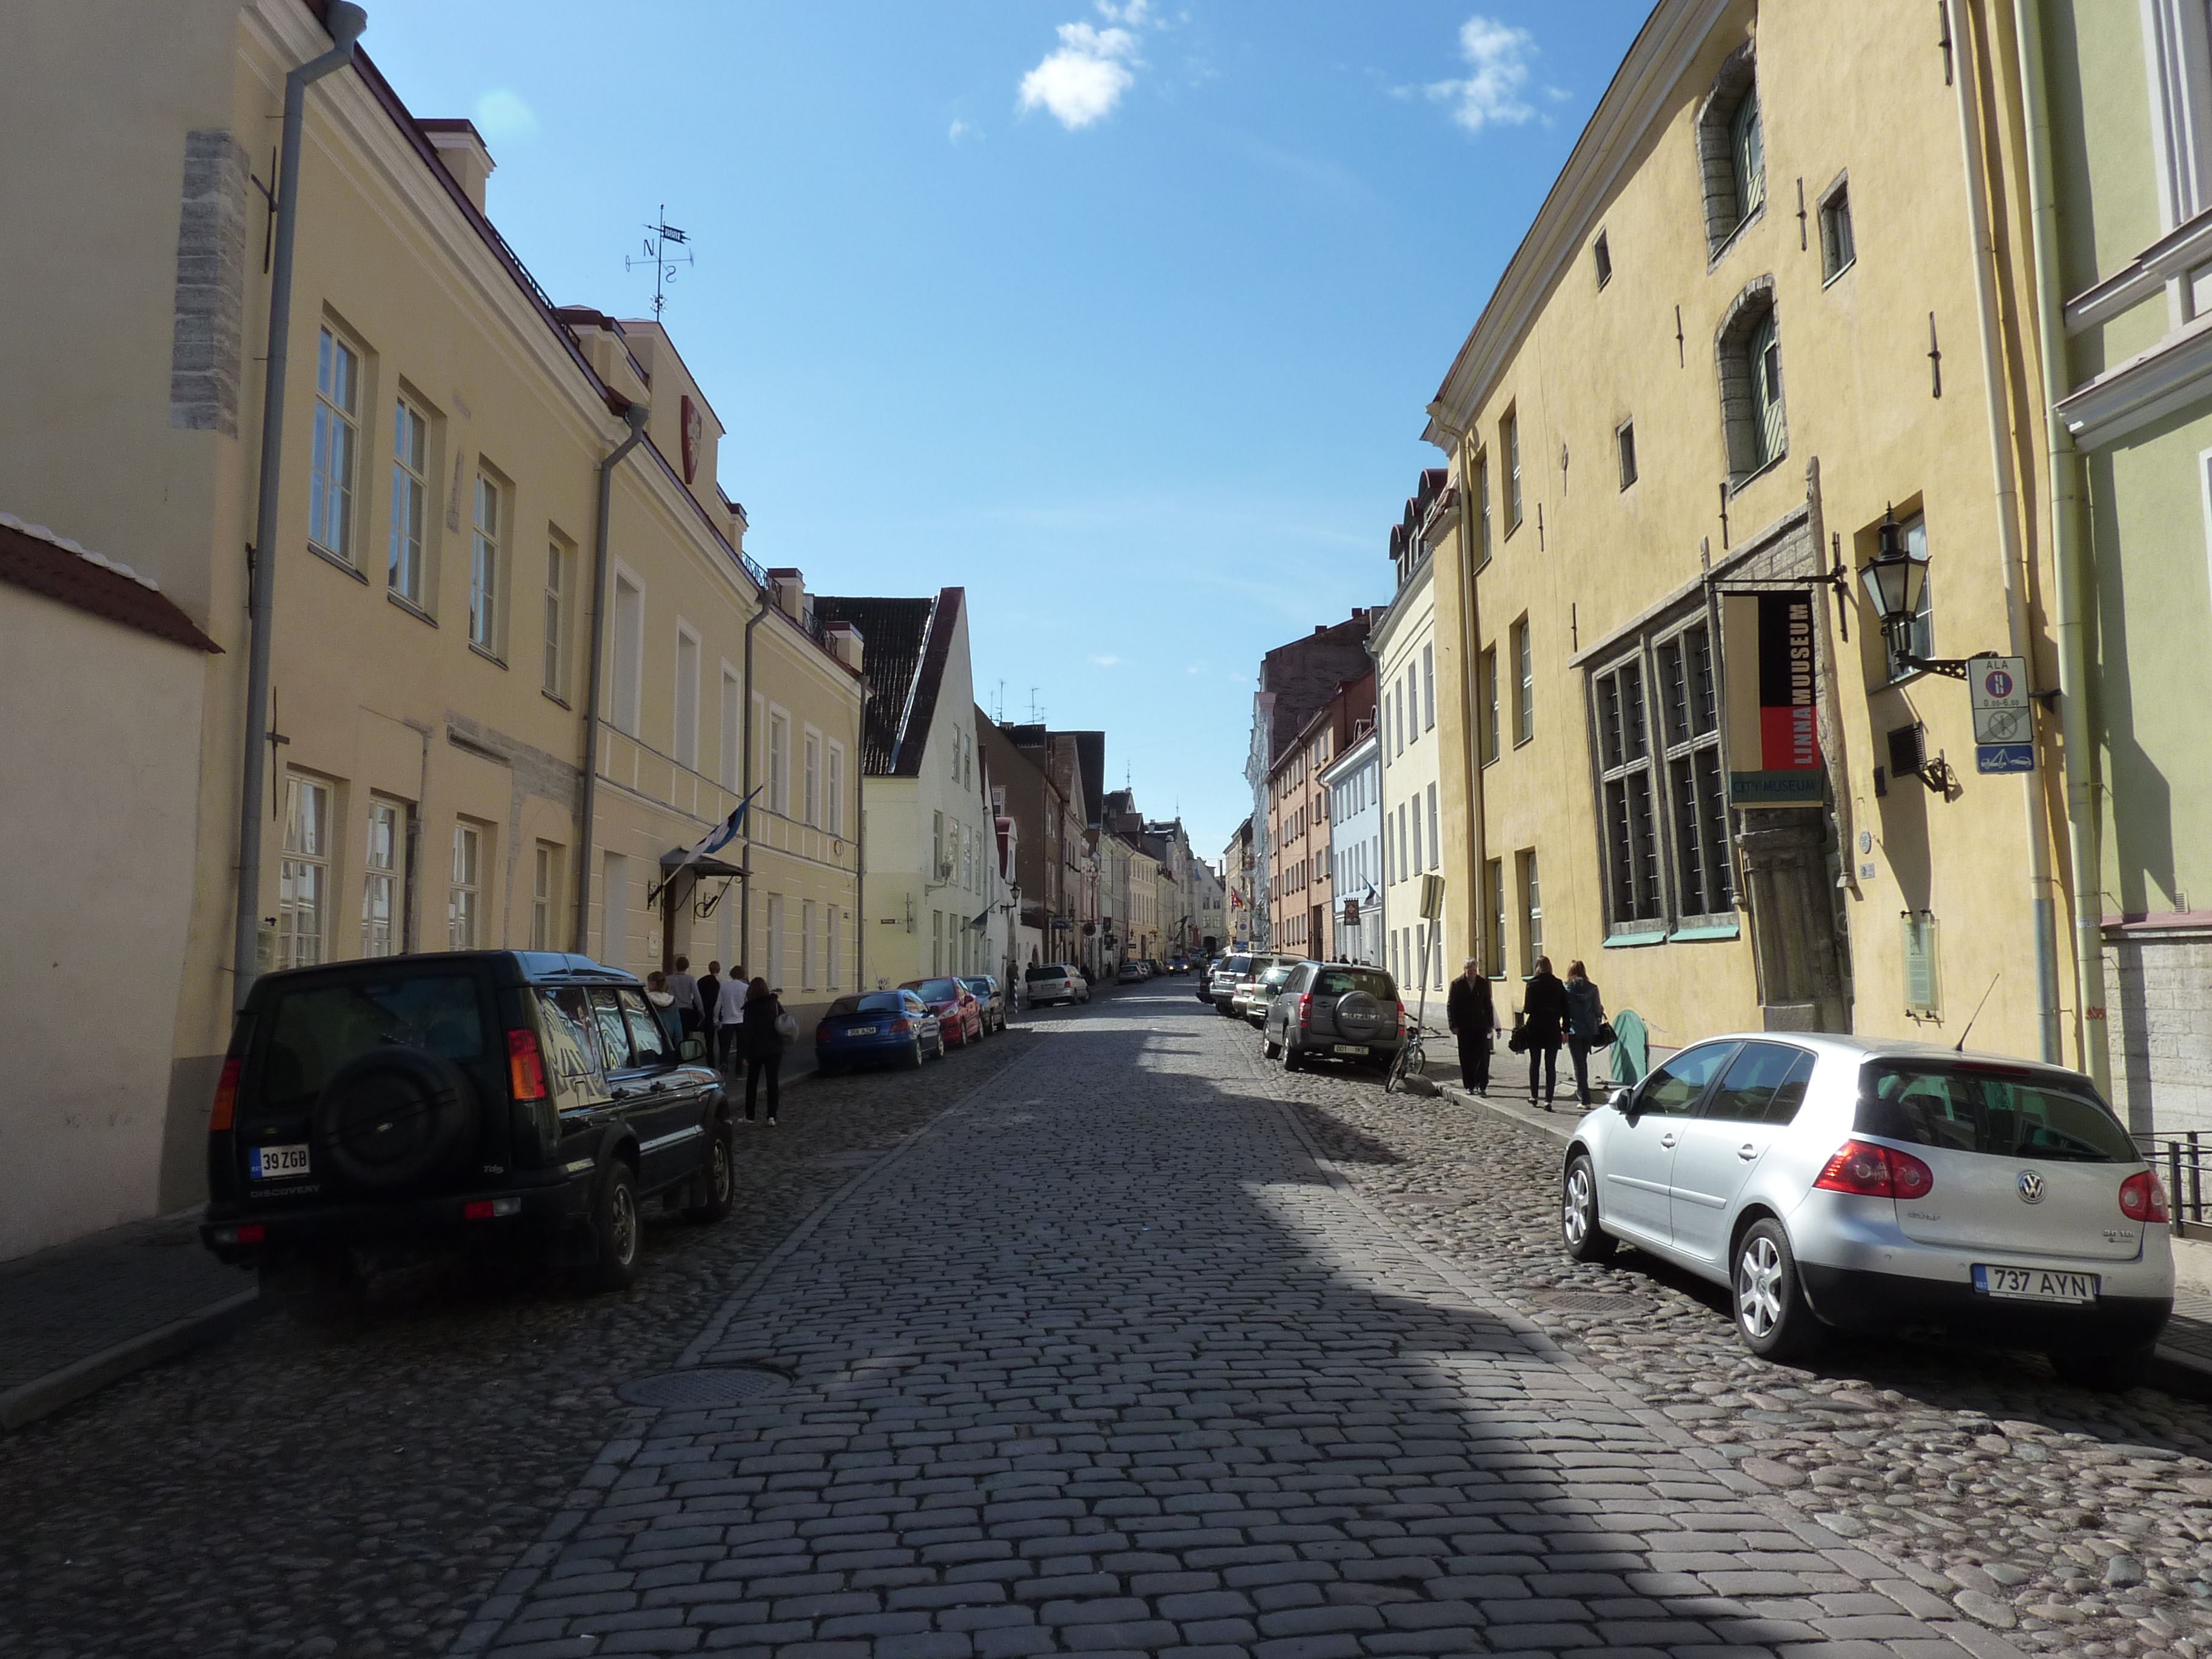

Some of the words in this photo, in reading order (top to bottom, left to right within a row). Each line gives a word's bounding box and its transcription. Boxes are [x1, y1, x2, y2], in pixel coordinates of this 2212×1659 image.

[1986, 660, 2008, 669] ALA
[1789, 604, 1813, 765] LINNAMUUSEUM
[1734, 781, 1760, 793] CITY
[1763, 779, 1815, 793] MUSEUM
[1341, 1013, 1381, 1021] SUZUKI
[263, 1153, 279, 1170] 39
[281, 1151, 307, 1168] ZGB
[250, 1184, 320, 1198] DISCOVERY
[1908, 1211, 1942, 1221] GOLF
[1994, 1270, 2030, 1292] 737
[2040, 1273, 2087, 1297] AYN
